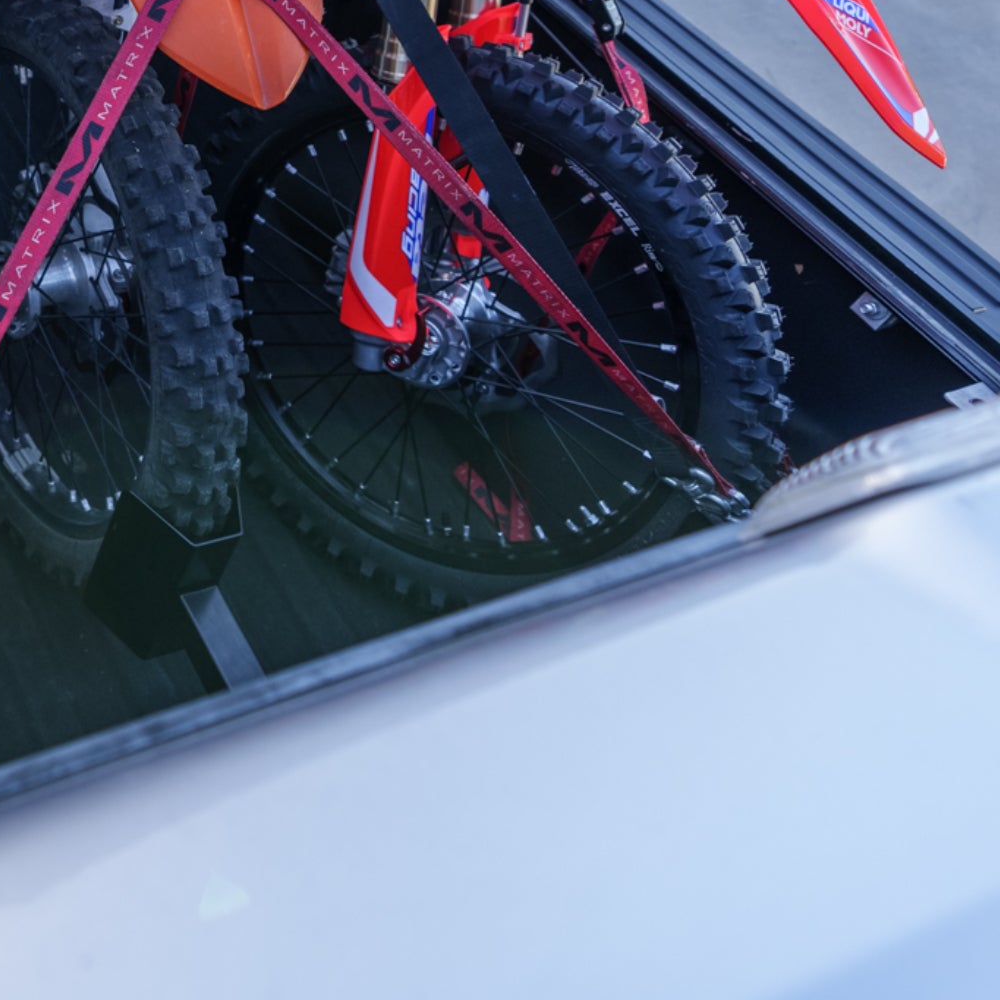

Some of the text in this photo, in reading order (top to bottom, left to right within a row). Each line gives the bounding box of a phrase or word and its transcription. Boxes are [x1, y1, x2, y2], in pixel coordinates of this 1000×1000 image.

[835, 10, 872, 38] MOLY
[97, 25, 154, 120] MATRIX
[281, 0, 351, 75] MATRIX
[398, 130, 463, 200] MATRIX
[507, 253, 570, 318] MATRIX
[1, 199, 62, 300] MATRIX
[600, 190, 642, 238] EXCEL
